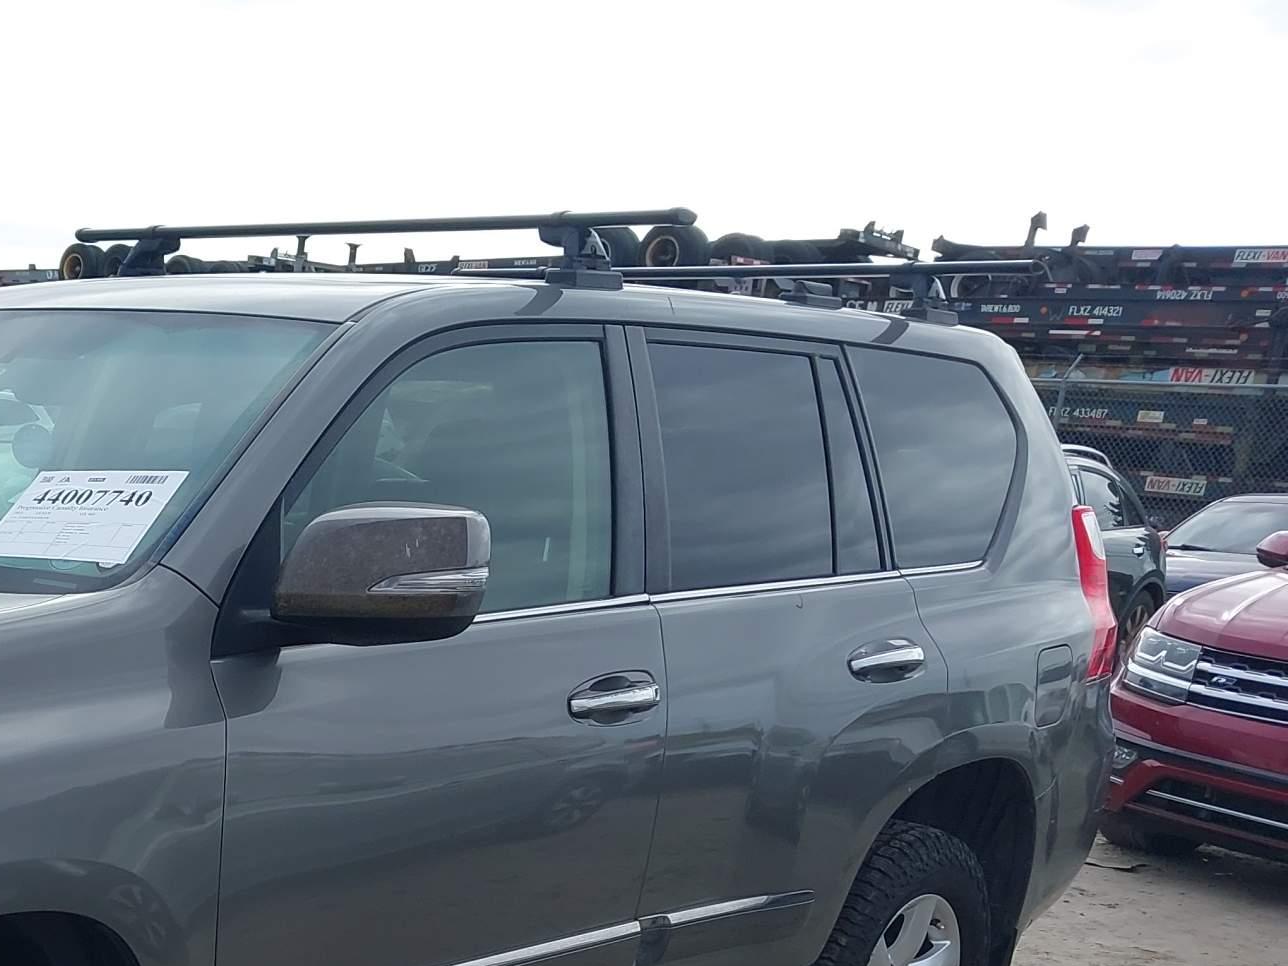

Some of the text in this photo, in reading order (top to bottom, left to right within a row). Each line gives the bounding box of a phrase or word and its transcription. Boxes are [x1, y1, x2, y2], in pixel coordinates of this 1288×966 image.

[1068, 305, 1123, 317] FLXZ 414321
[1171, 367, 1252, 385] FLEXI-VAN
[1146, 477, 1206, 495] FLEXI-VAN
[32, 488, 153, 507] 44007740
